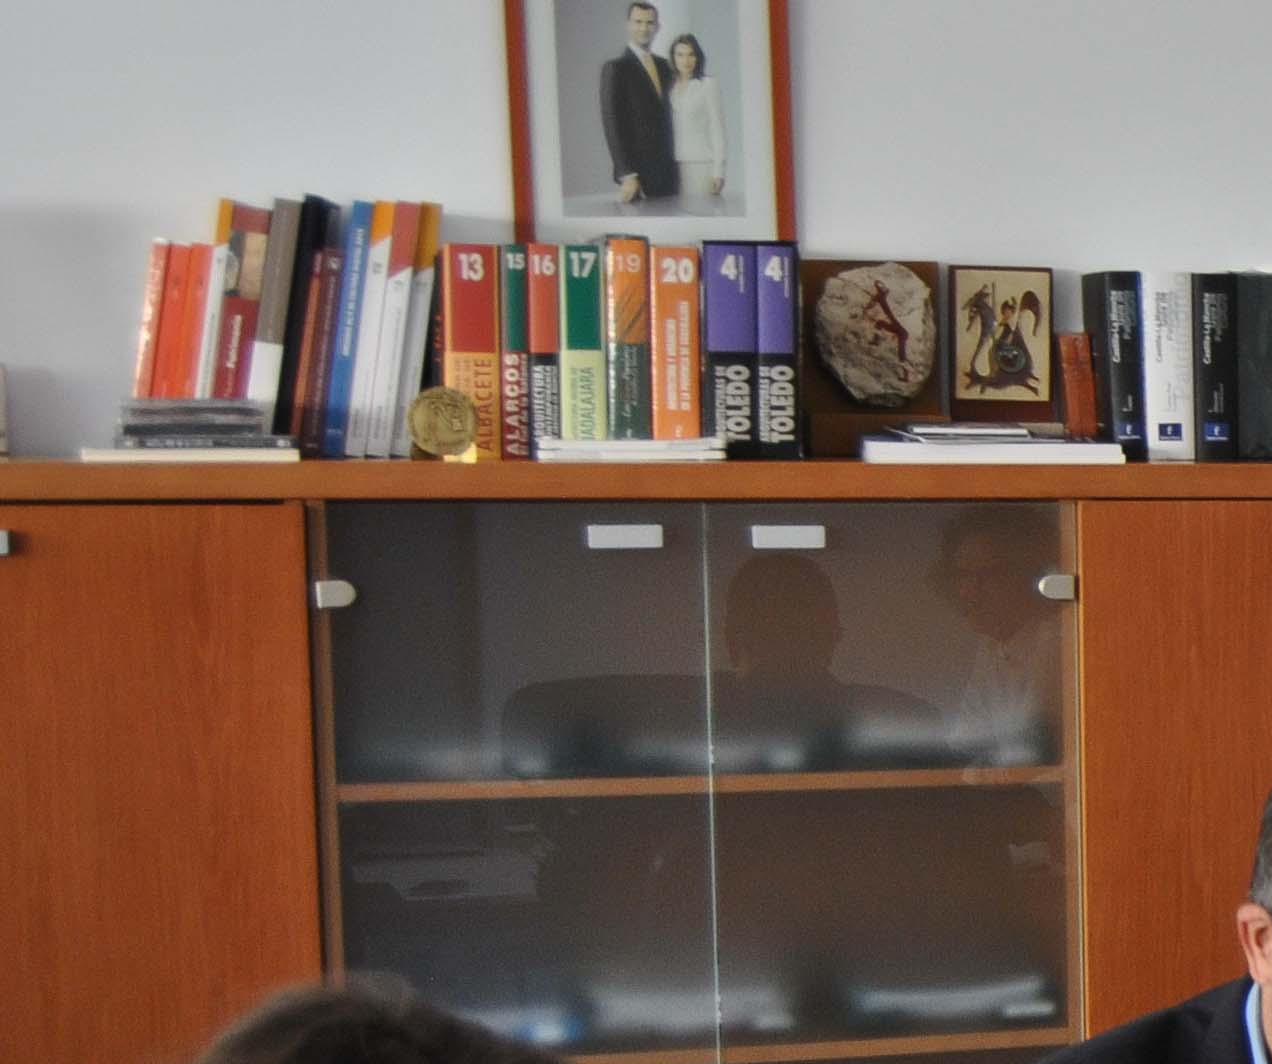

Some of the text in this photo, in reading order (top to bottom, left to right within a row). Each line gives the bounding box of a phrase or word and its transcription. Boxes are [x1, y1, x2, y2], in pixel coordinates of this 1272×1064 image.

[457, 252, 485, 282] 13
[505, 252, 526, 270] 15
[530, 252, 556, 276] 16
[569, 252, 597, 279] 17
[615, 254, 641, 274] 19
[661, 257, 694, 284] 20
[720, 253, 738, 281] 4
[764, 255, 783, 282] 4
[473, 358, 493, 453] ALBACETE
[503, 354, 520, 456] ALARCOS
[725, 364, 751, 443] TOLEDO
[770, 364, 796, 444] TOLEDO
